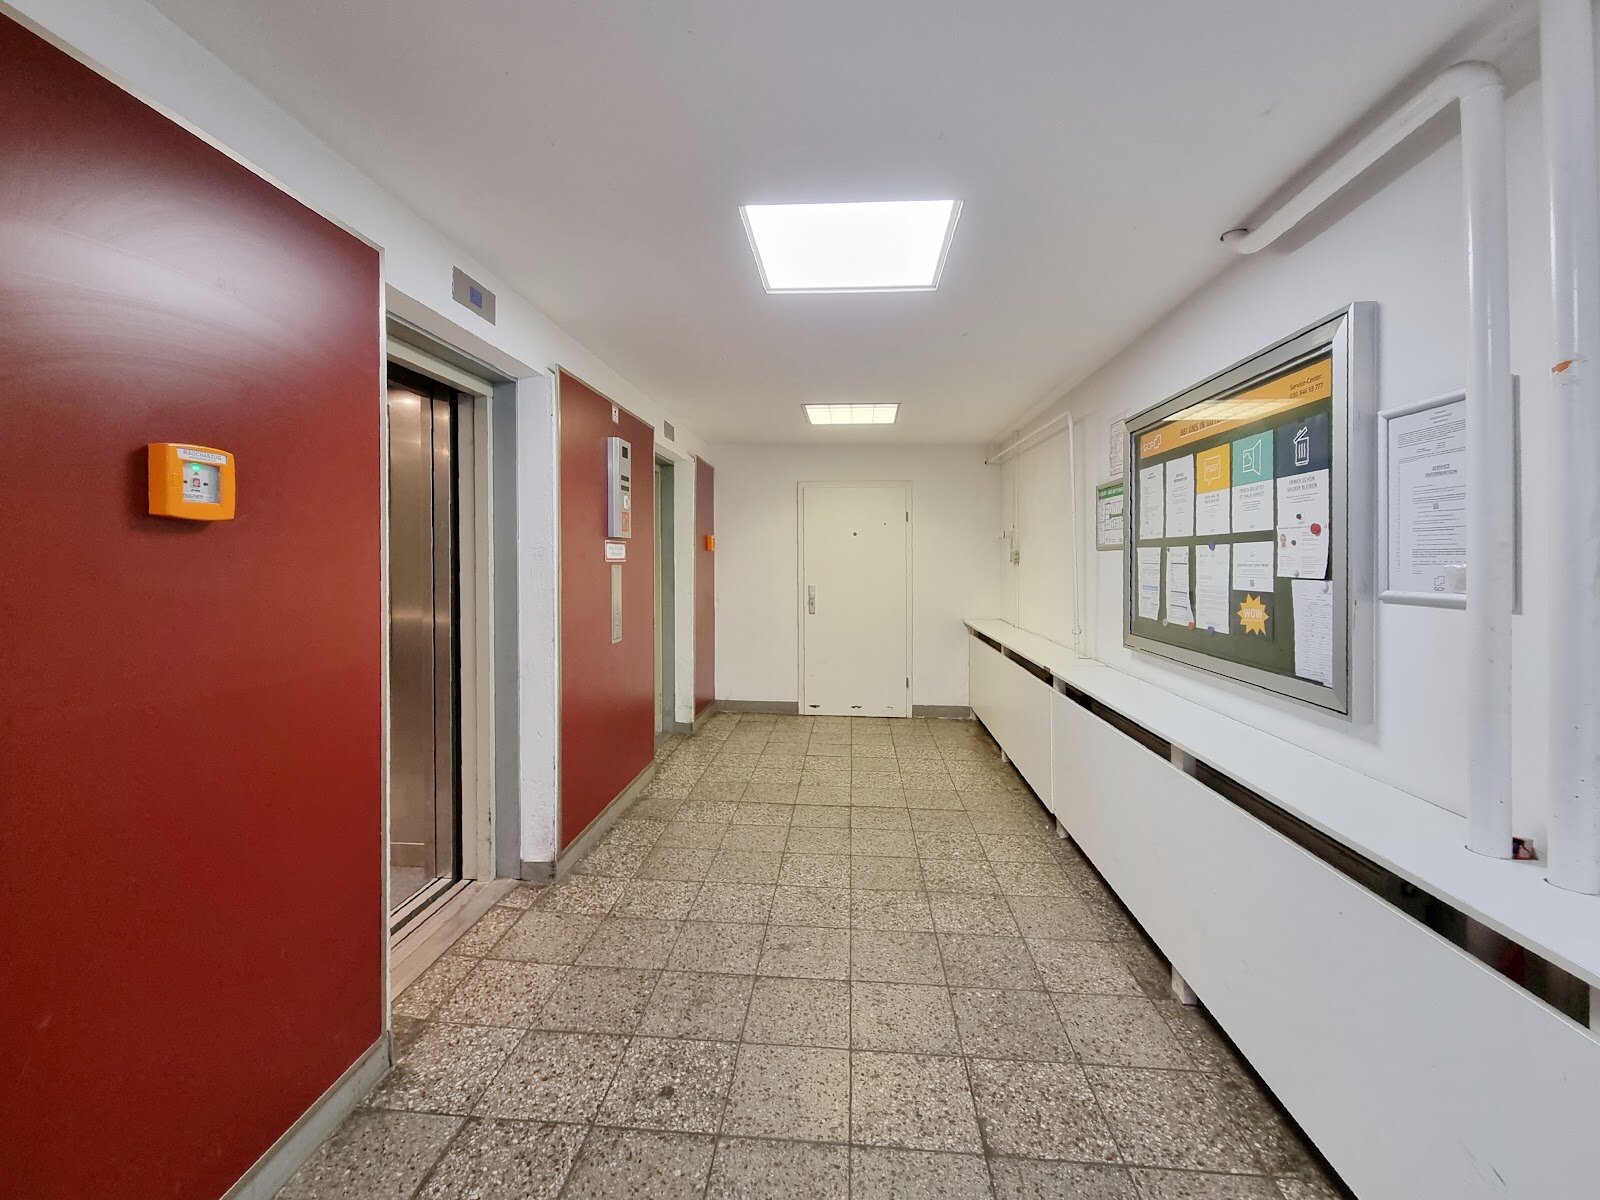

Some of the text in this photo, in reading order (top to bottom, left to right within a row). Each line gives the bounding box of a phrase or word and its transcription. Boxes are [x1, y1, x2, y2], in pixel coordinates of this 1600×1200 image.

[182, 449, 222, 461] RAUCHABZUG
[1432, 463, 1450, 471] SERVICE
[1425, 469, 1457, 478] INFORMATION
[1244, 608, 1263, 619] WOW
